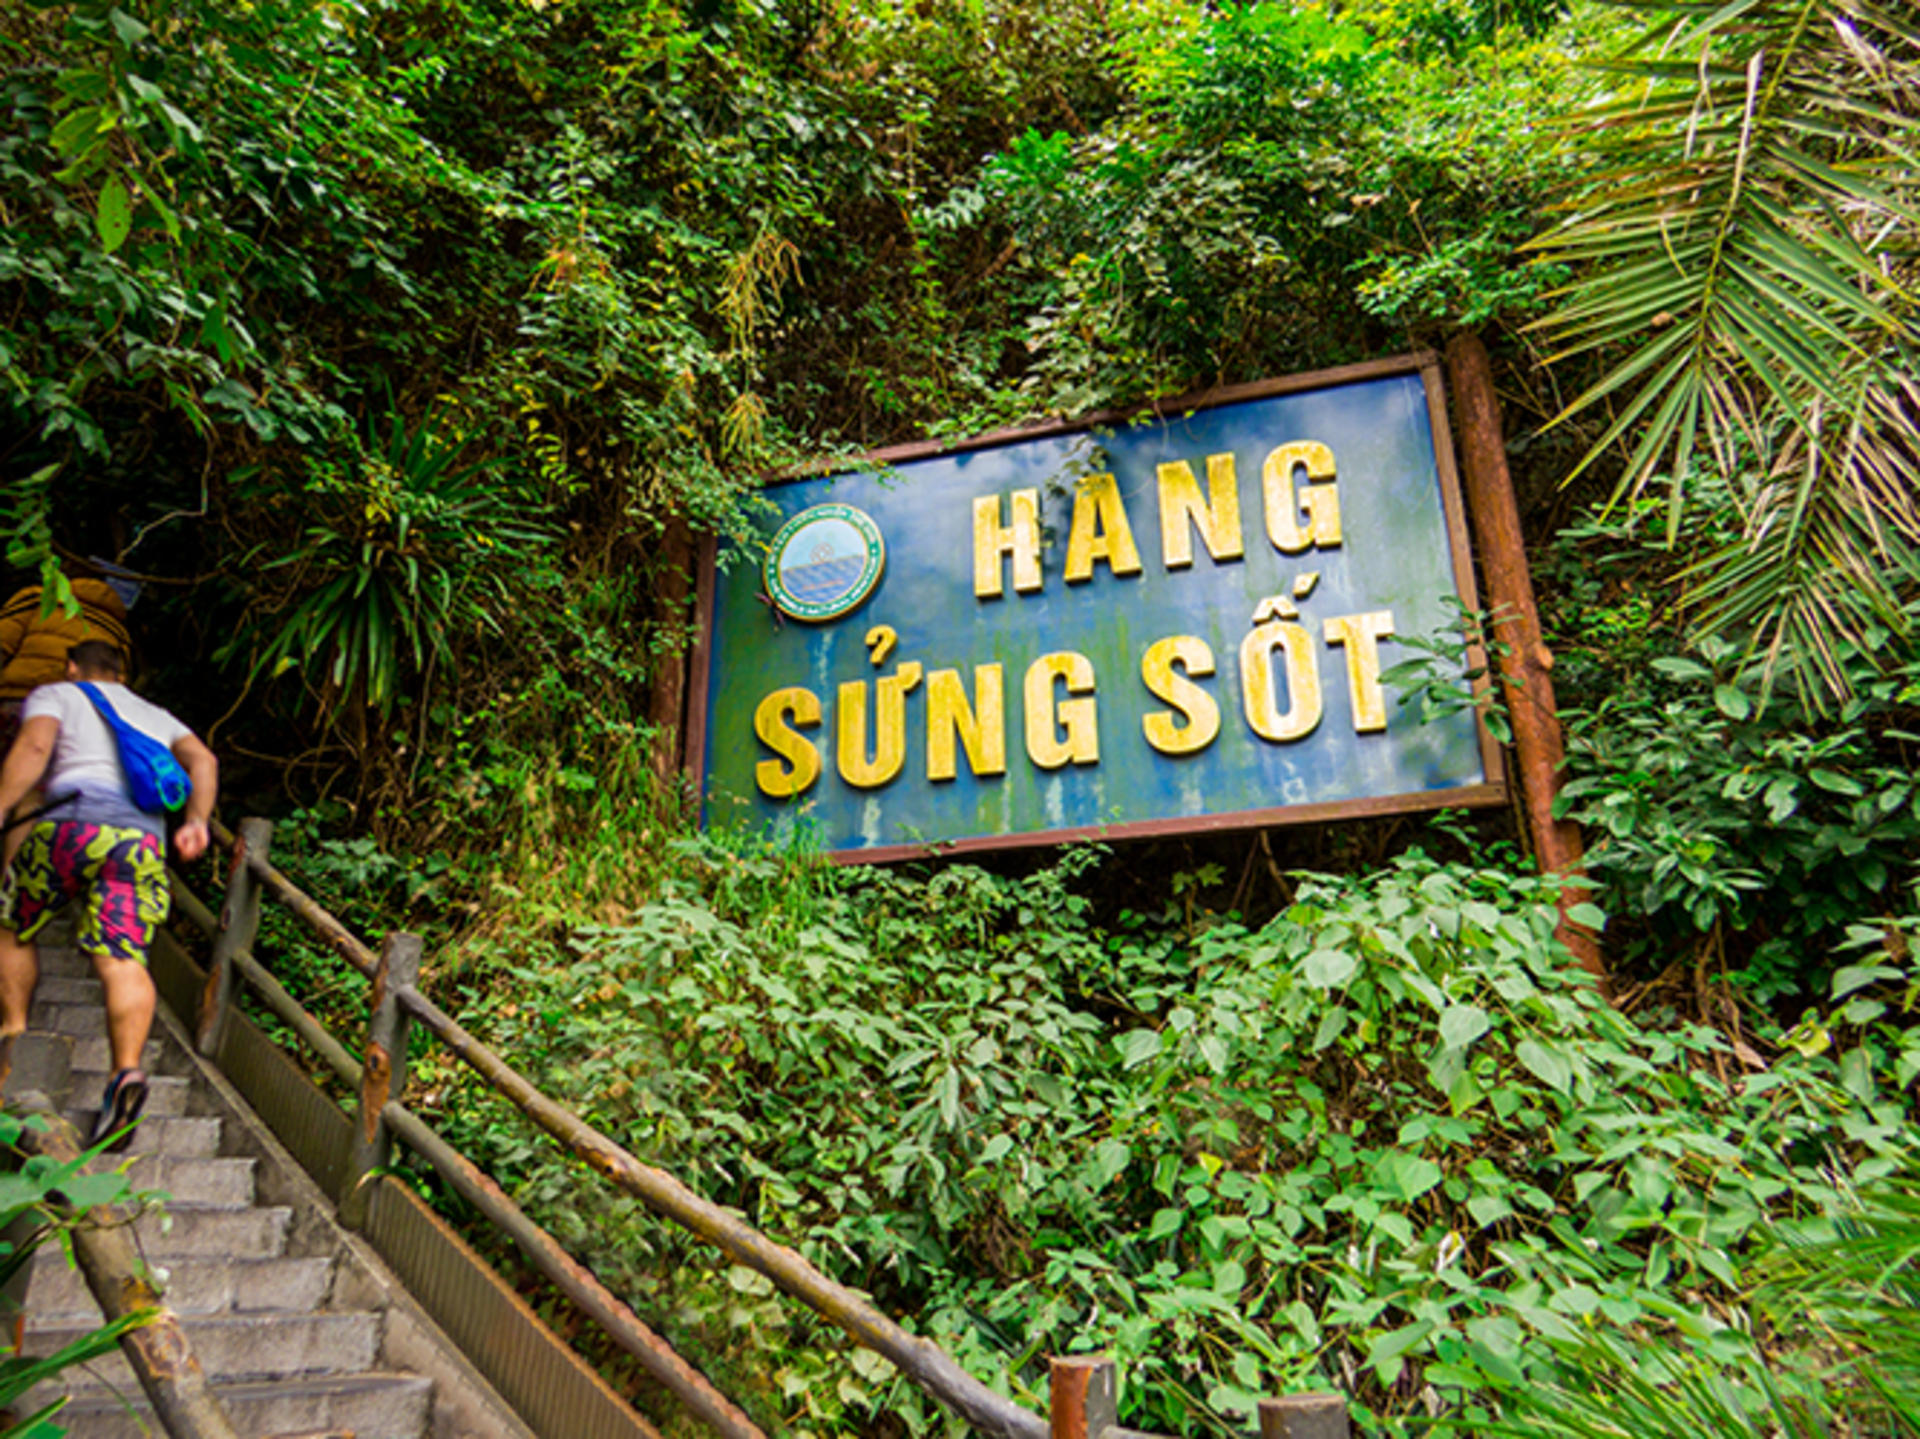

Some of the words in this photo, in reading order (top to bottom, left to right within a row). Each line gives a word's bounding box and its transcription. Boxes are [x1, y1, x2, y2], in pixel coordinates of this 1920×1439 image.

[972, 441, 1343, 599] HANG
[755, 626, 1101, 797] SỬNG
[1142, 572, 1394, 755] SỐT
